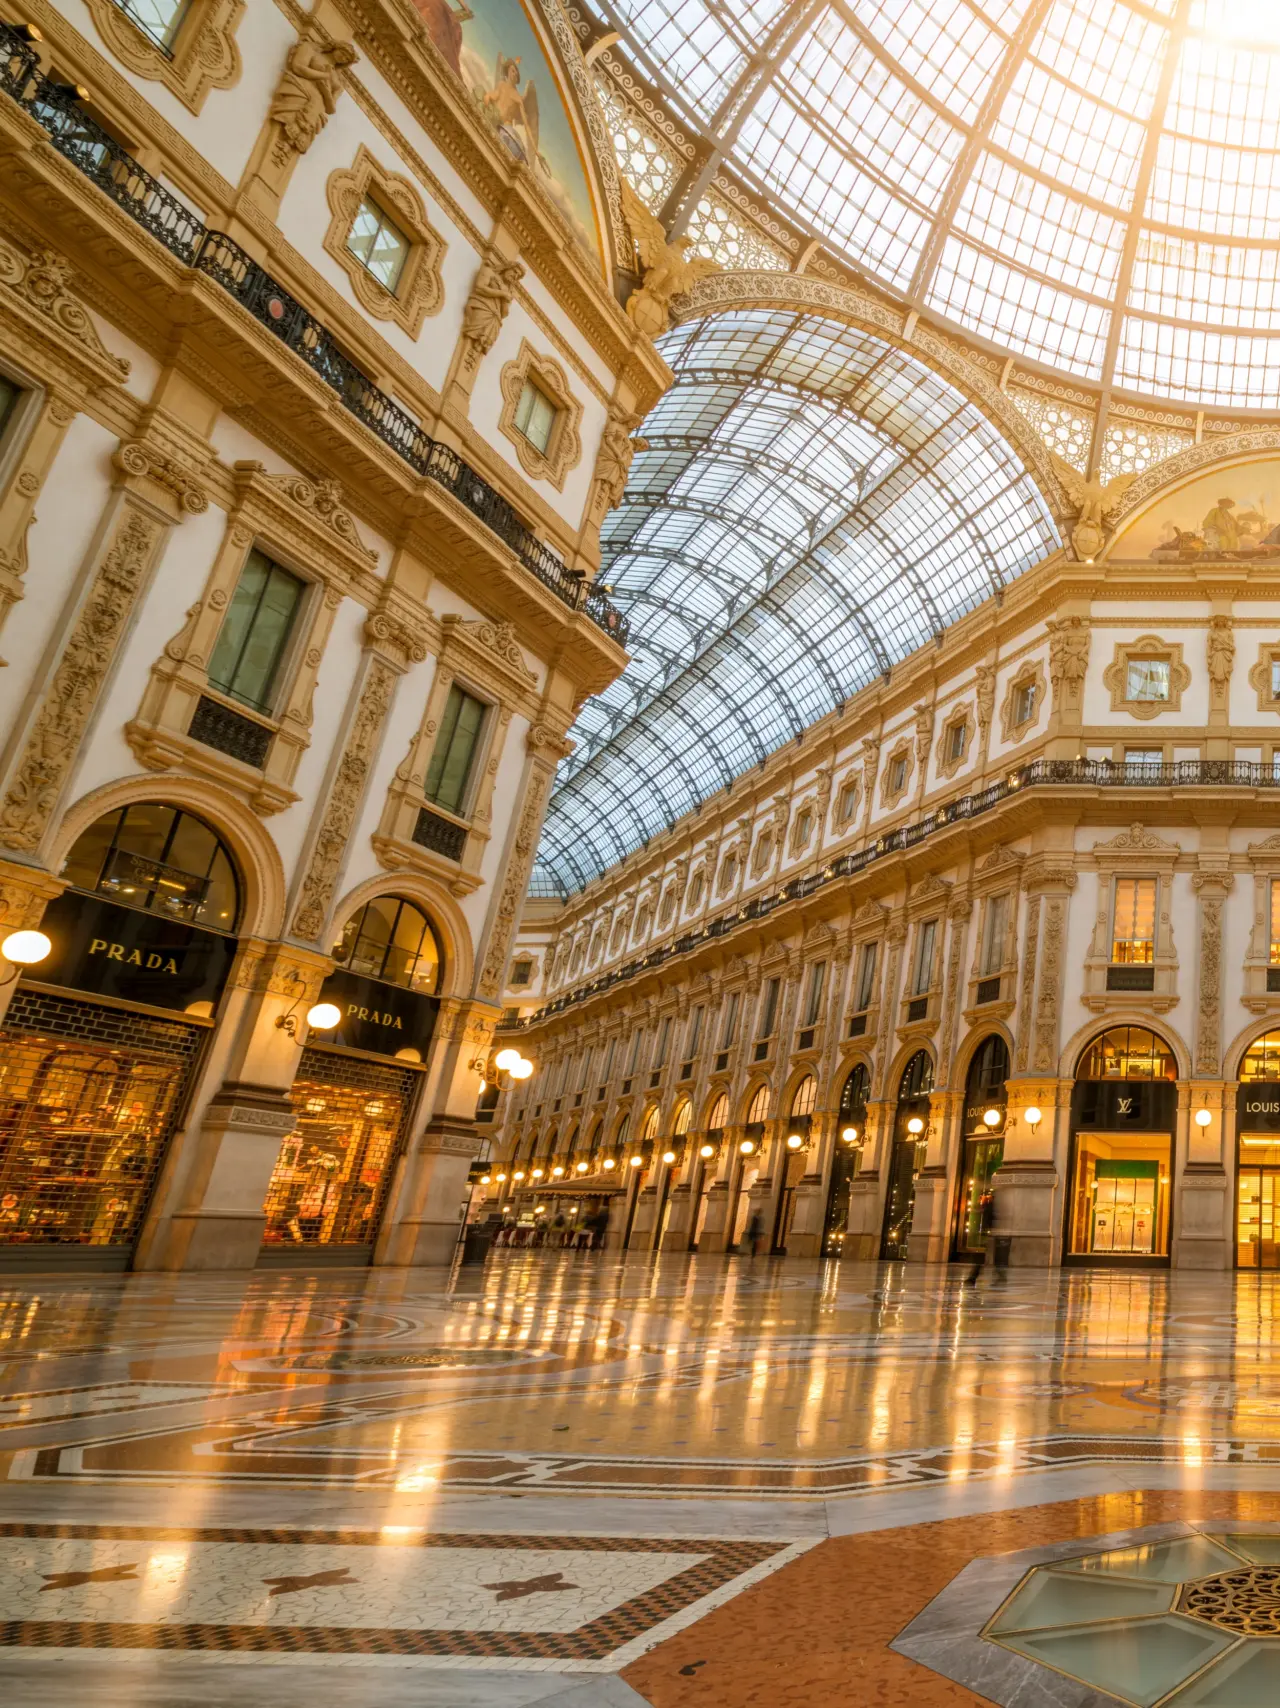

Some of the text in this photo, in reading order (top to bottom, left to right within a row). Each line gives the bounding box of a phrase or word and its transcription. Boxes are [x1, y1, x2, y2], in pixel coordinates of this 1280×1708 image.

[88, 938, 178, 975] PRADA
[346, 1003, 403, 1030] PRADA
[1246, 1101, 1280, 1113] LOUIS
